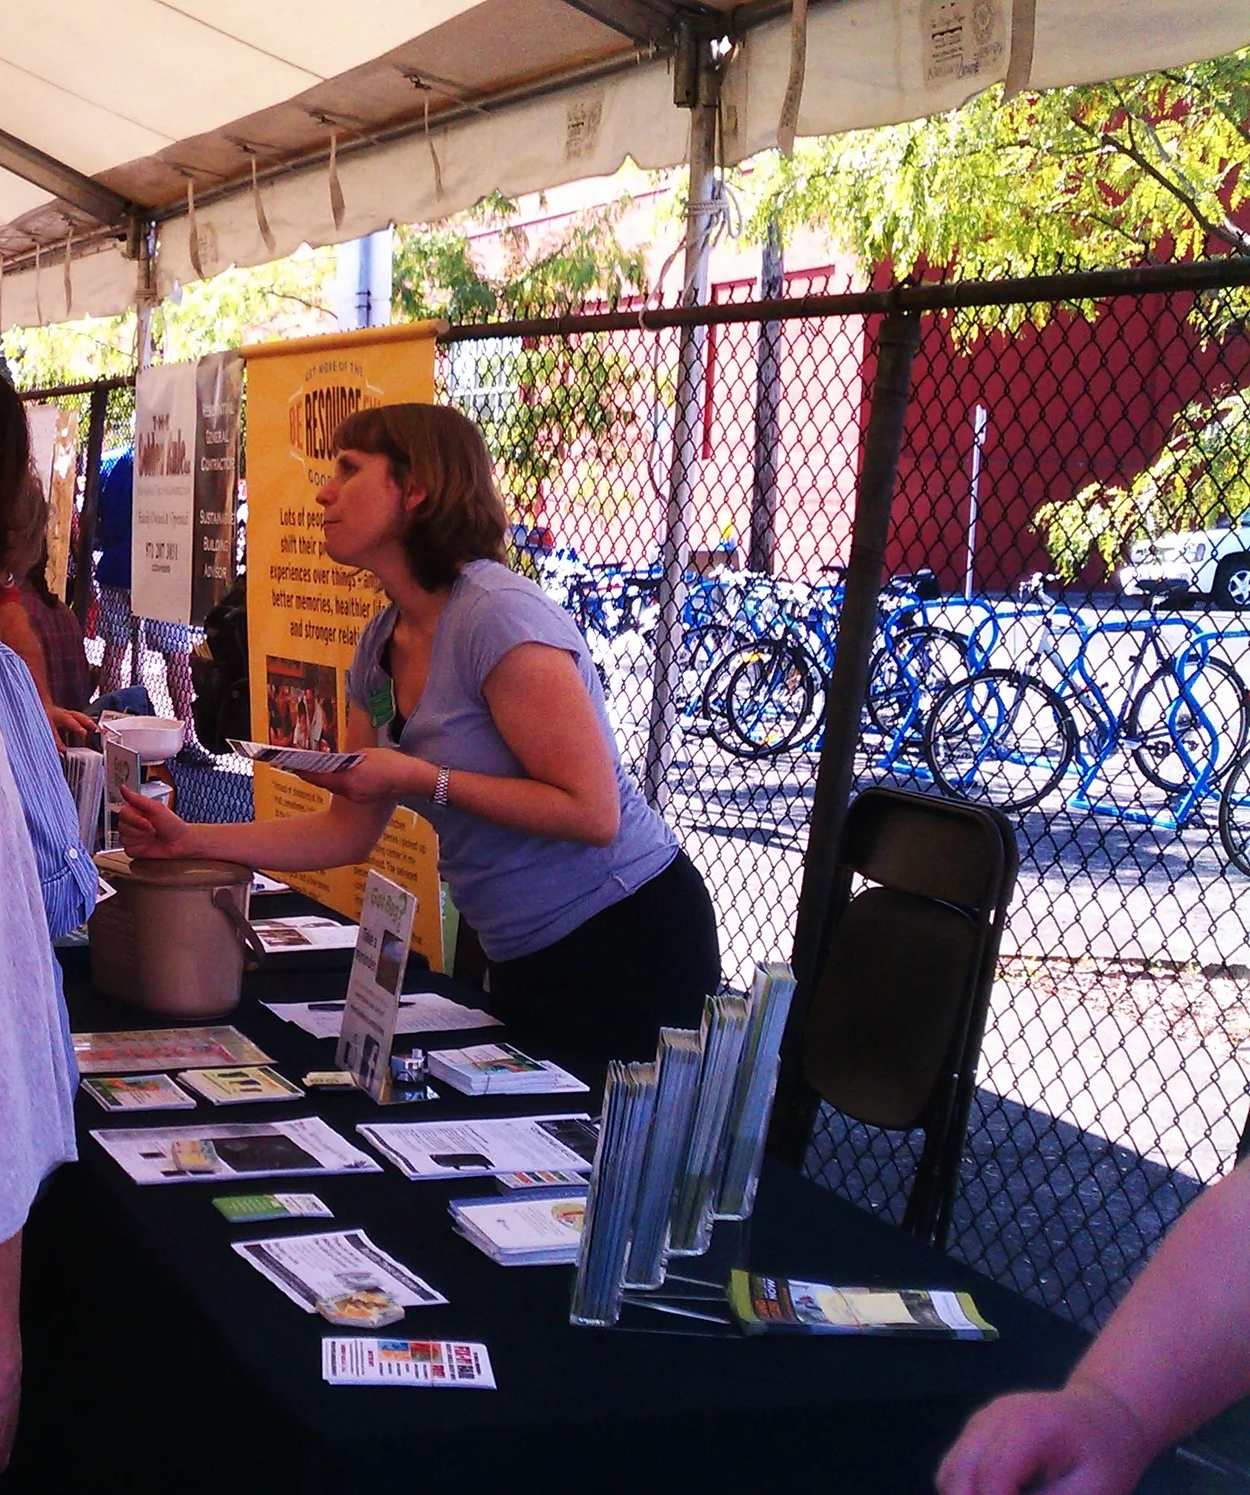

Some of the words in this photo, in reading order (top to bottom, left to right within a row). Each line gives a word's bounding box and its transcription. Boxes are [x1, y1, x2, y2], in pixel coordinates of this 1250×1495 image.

[308, 469, 332, 486] GOO
[280, 508, 296, 526] Lots
[297, 507, 305, 527] of
[307, 512, 325, 531] peop
[281, 535, 297, 554] shift
[299, 536, 316, 555] their
[270, 563, 311, 584] experiences
[313, 568, 330, 585] over
[332, 566, 356, 591] things
[272, 588, 294, 608] better
[295, 593, 333, 617] memories,
[335, 595, 371, 619] healthier
[290, 619, 303, 638] and
[305, 620, 337, 647] stronger
[338, 625, 361, 646] relati
